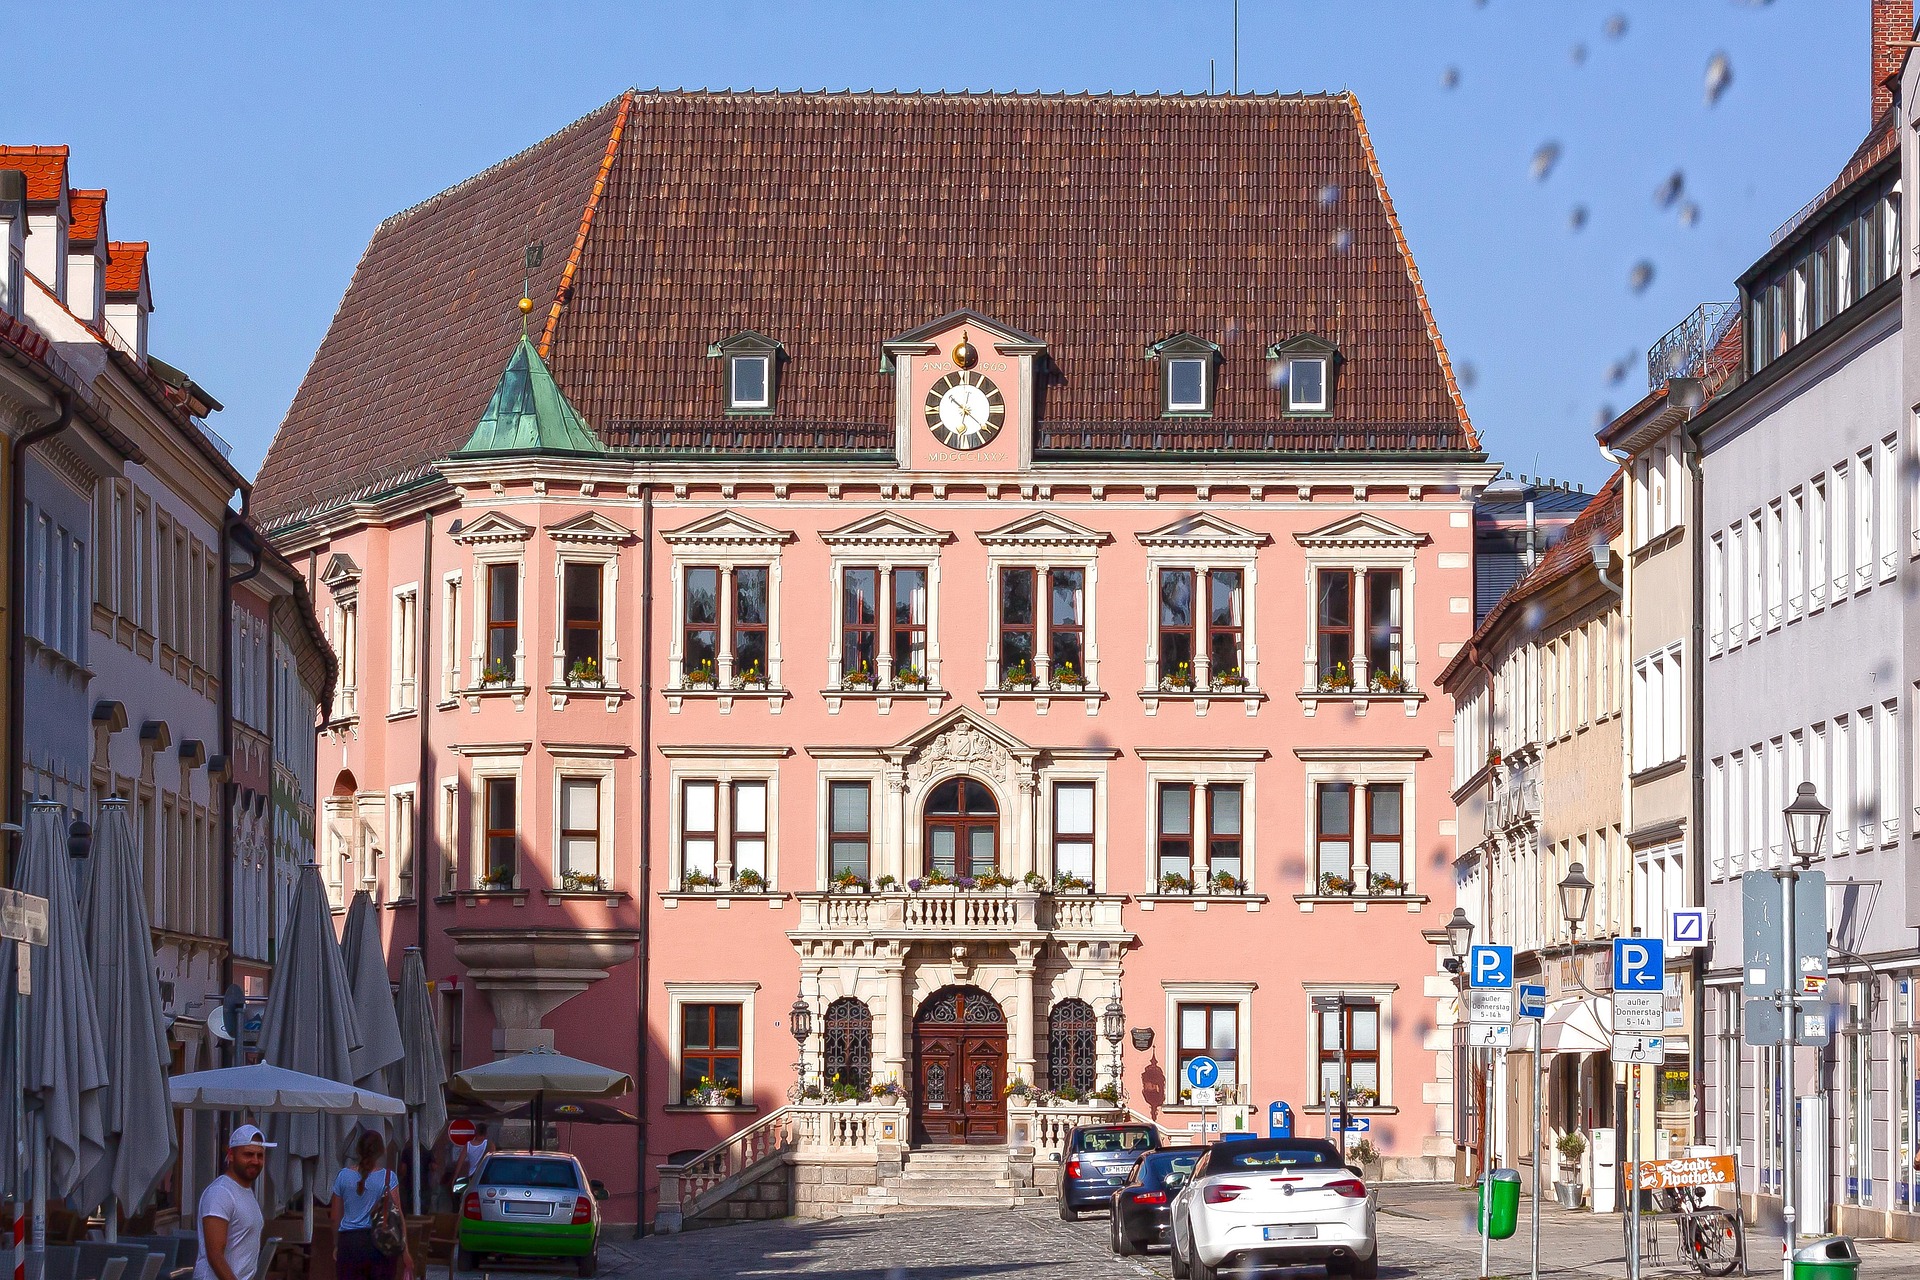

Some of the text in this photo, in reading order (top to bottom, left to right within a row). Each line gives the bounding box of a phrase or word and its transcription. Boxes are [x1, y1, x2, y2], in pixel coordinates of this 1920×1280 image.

[978, 362, 1007, 372] 1960
[1477, 949, 1501, 983] P
[1622, 943, 1649, 985] P
[1472, 1003, 1510, 1011] Donnerstag
[1627, 998, 1650, 1006] außer
[1616, 1008, 1661, 1017] Donnerstag
[1660, 1169, 1726, 1188] Apotheke
